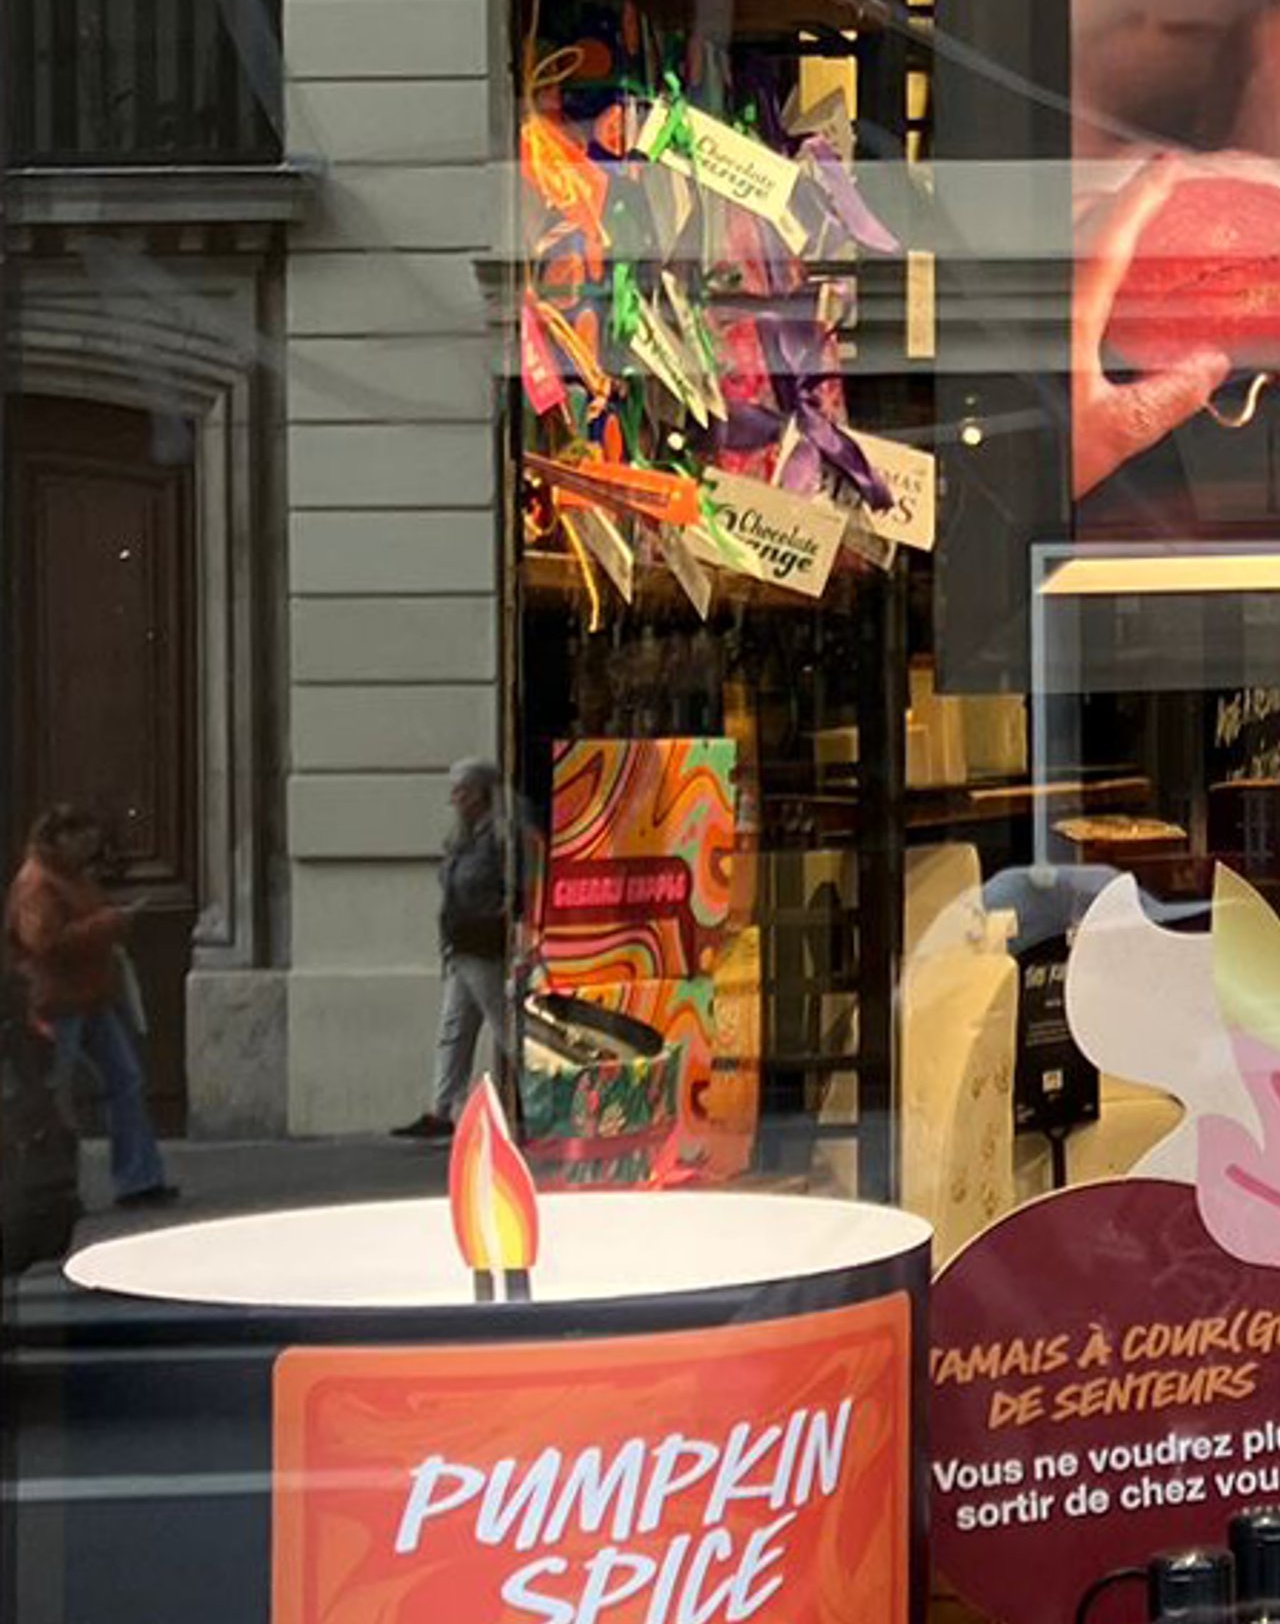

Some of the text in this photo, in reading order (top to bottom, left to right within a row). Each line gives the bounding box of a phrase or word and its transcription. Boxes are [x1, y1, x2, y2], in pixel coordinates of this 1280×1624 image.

[739, 508, 820, 557] Chocolate
[1078, 1323, 1113, 1368] À
[988, 1363, 1259, 1429] DE SENTEURS
[396, 1397, 851, 1553] PUMPKIN
[933, 1455, 1023, 1492] Vous
[1035, 1452, 1079, 1478] ne
[1089, 1432, 1233, 1473] voudrez
[957, 1489, 1054, 1531] sortir
[1065, 1480, 1110, 1513] de
[1120, 1473, 1206, 1509] chez
